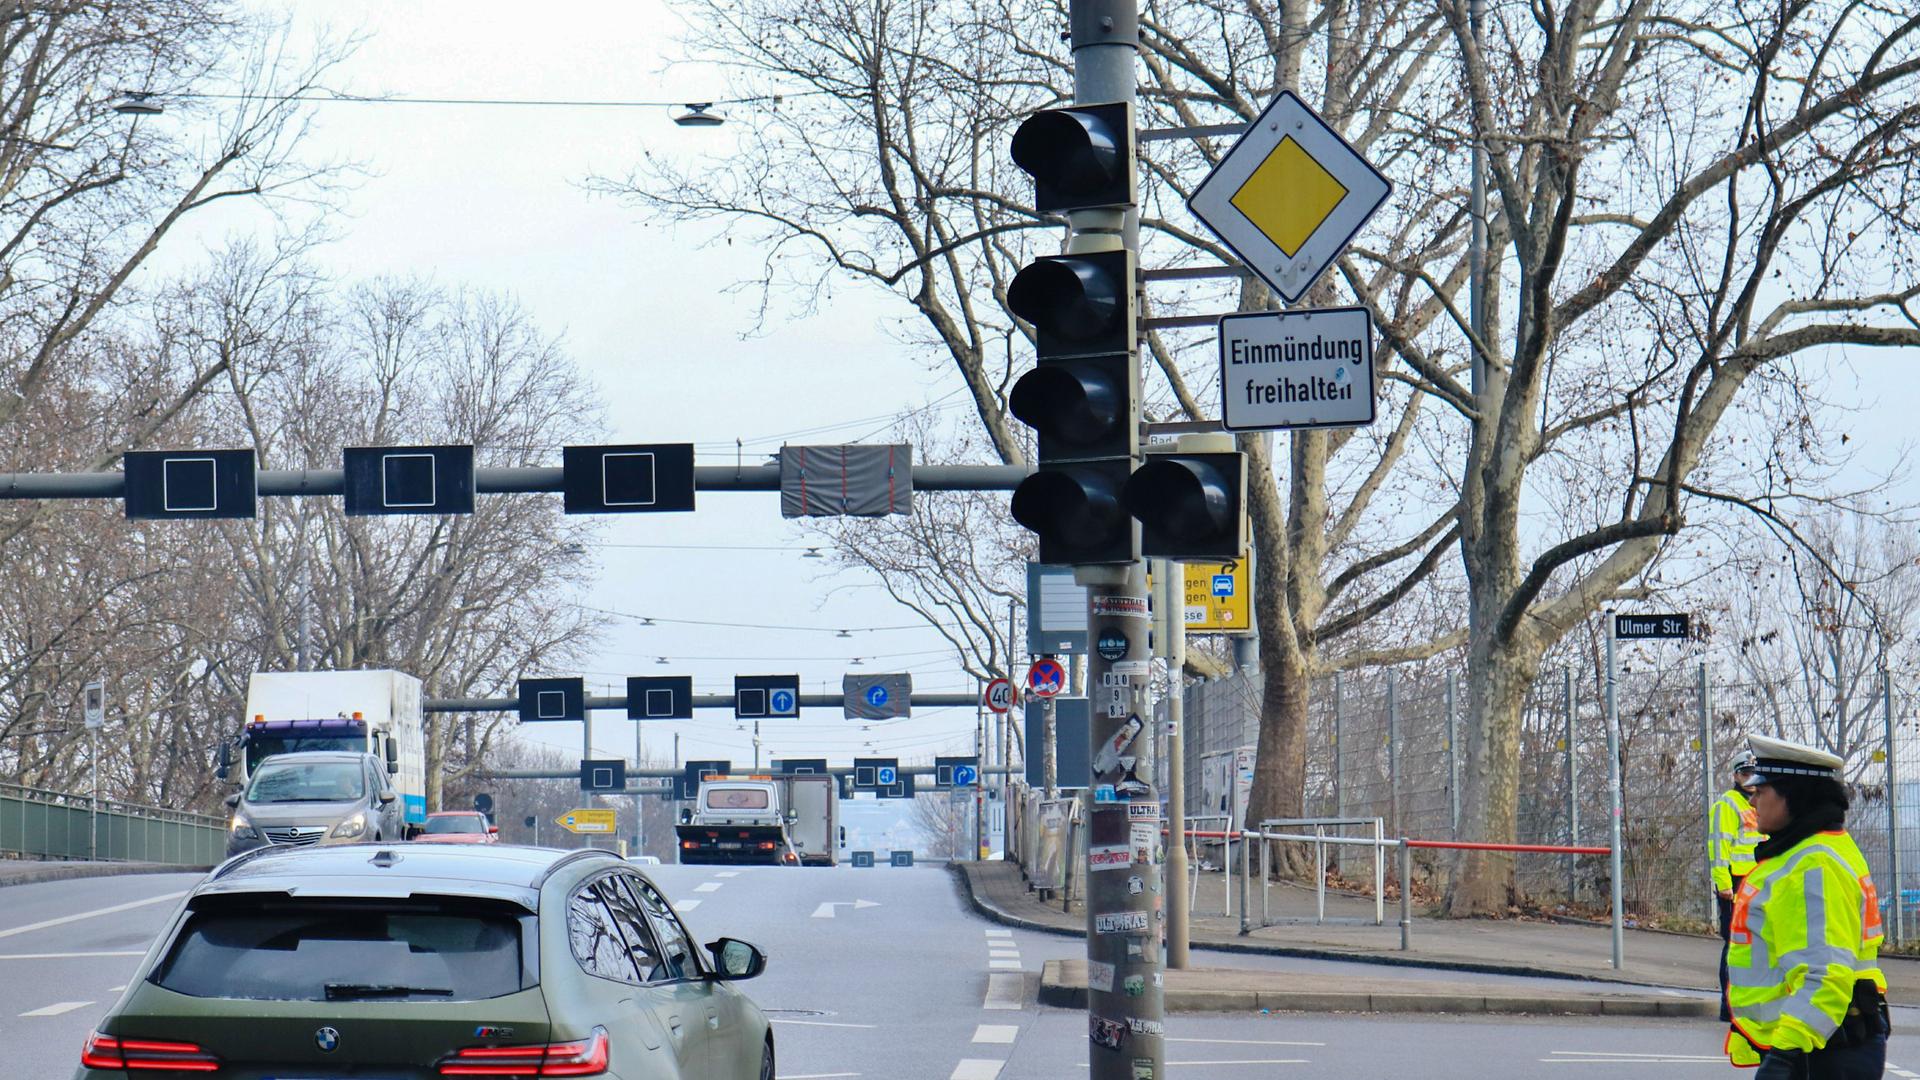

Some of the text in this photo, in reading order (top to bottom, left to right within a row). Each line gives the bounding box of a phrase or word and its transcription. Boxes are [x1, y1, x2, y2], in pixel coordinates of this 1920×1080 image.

[1231, 335, 1363, 365] Einmündung
[1620, 619, 1684, 634] Ulmer Str.
[1105, 674, 1127, 685] 010
[1114, 690, 1120, 701] 9
[1110, 705, 1125, 715] 81
